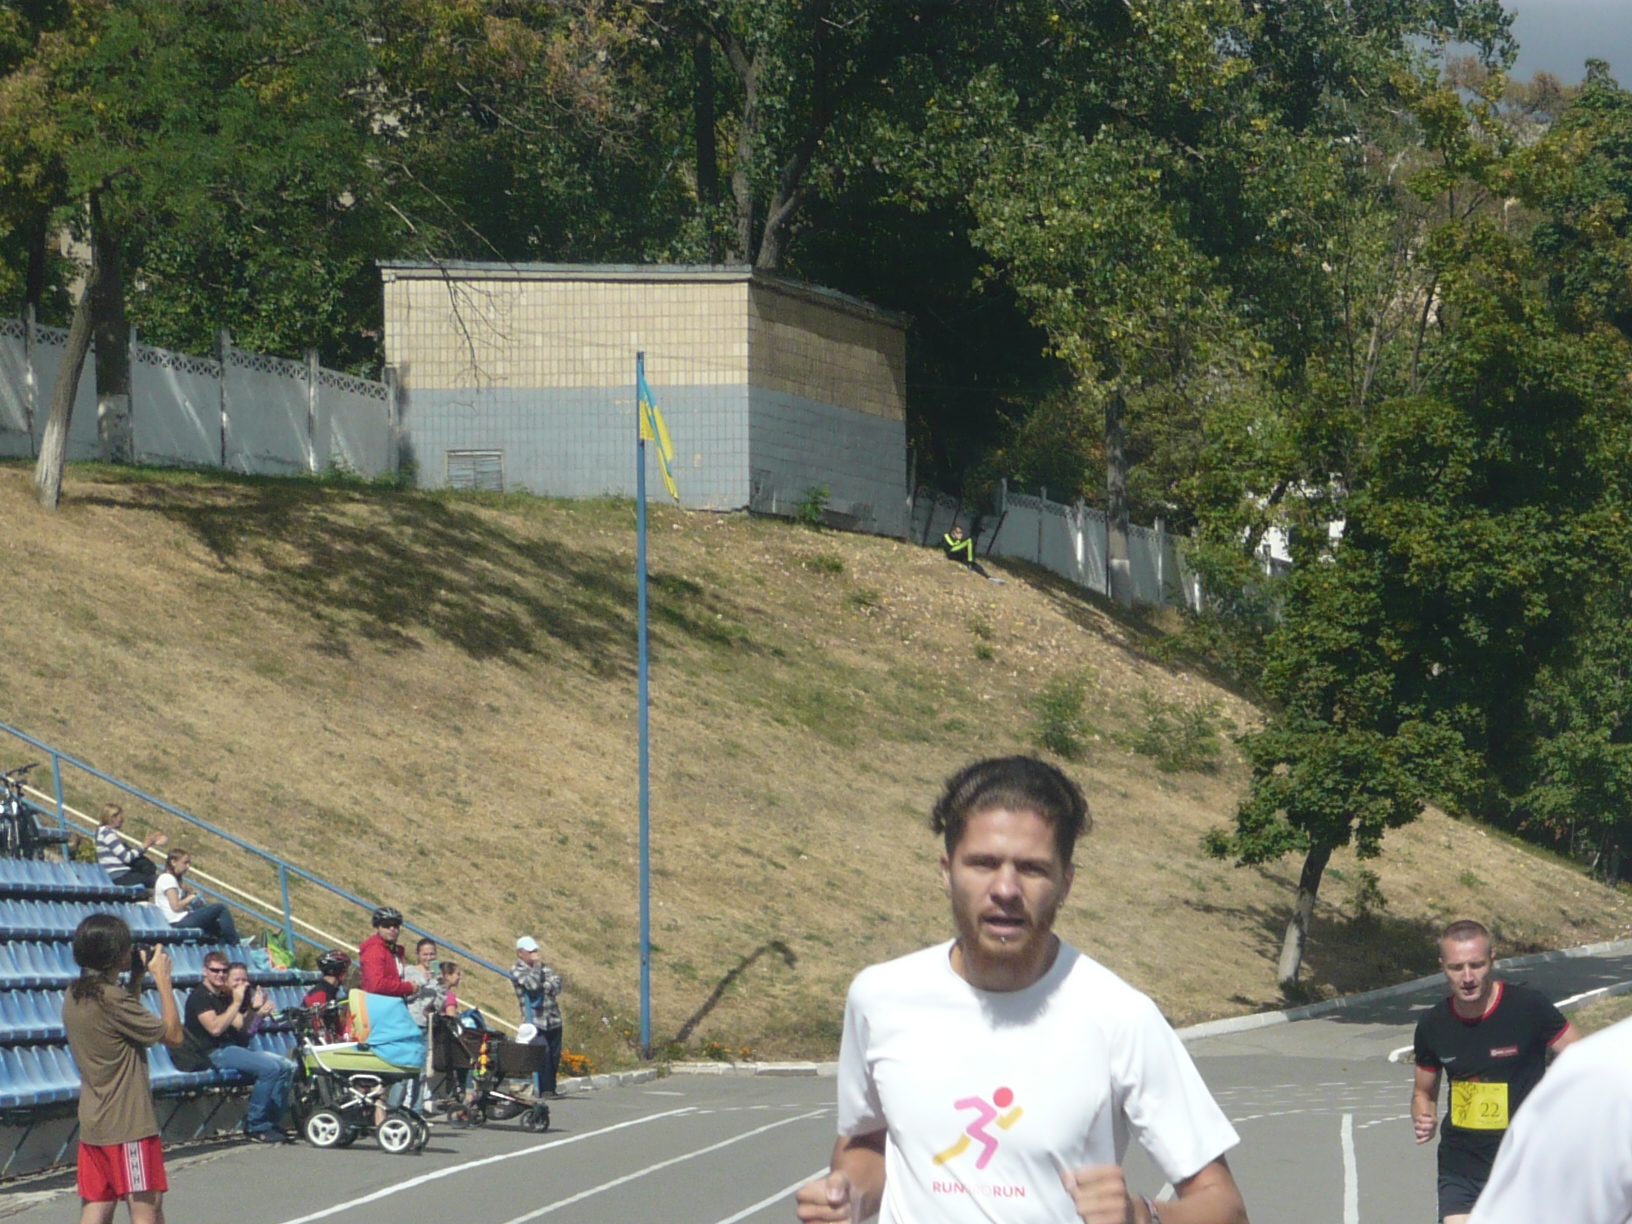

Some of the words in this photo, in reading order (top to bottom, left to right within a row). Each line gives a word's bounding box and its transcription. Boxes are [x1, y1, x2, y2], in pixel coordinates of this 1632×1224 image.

[1480, 1102, 1500, 1118] 22
[932, 1180, 966, 1195] RUN
[992, 1184, 1026, 1199] RUN
